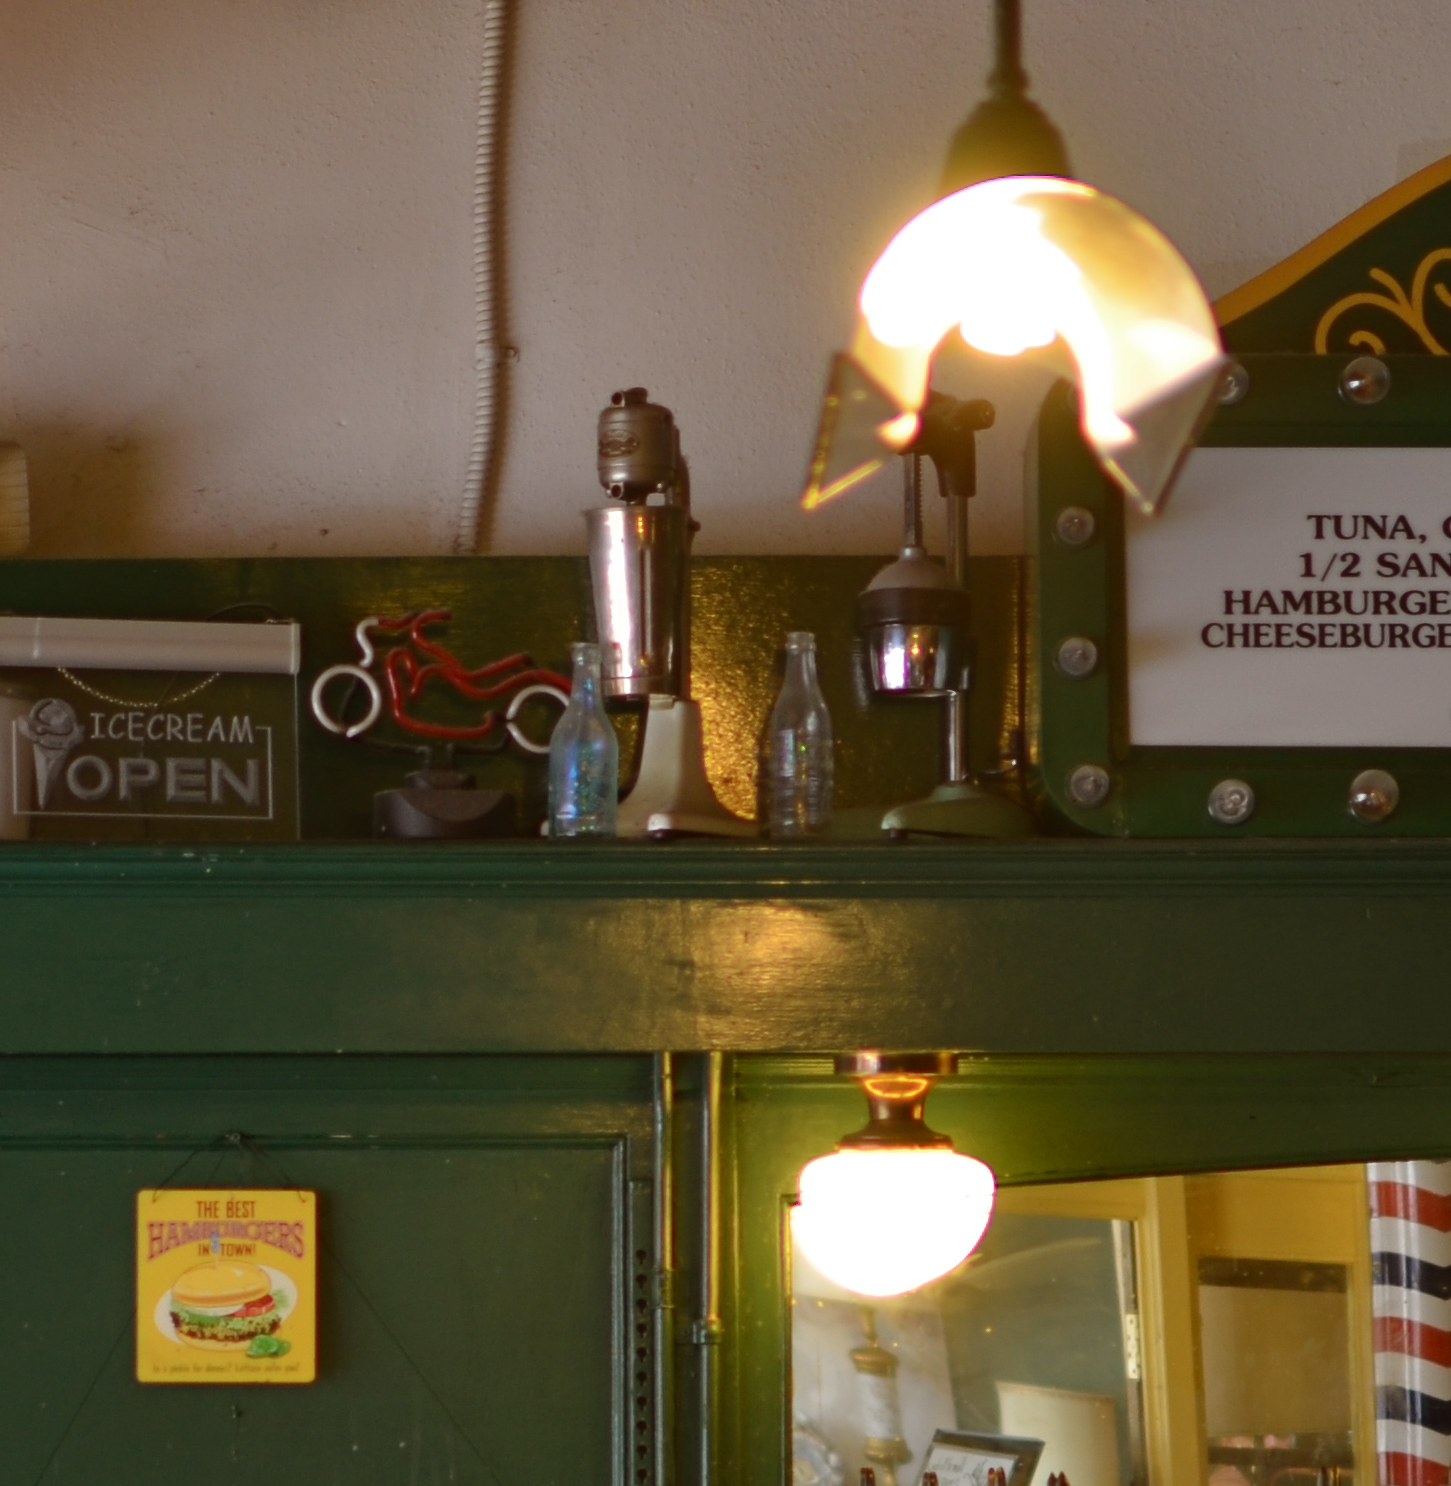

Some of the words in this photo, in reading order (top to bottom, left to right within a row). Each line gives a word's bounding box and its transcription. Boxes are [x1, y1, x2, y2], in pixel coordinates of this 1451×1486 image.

[1307, 515, 1426, 543] TUNA,
[1300, 552, 1360, 581] 1/2
[66, 755, 260, 806] OPEN
[196, 1200, 220, 1219] THE
[226, 1200, 257, 1219] BEST
[147, 1221, 305, 1262] HAMBURGERS
